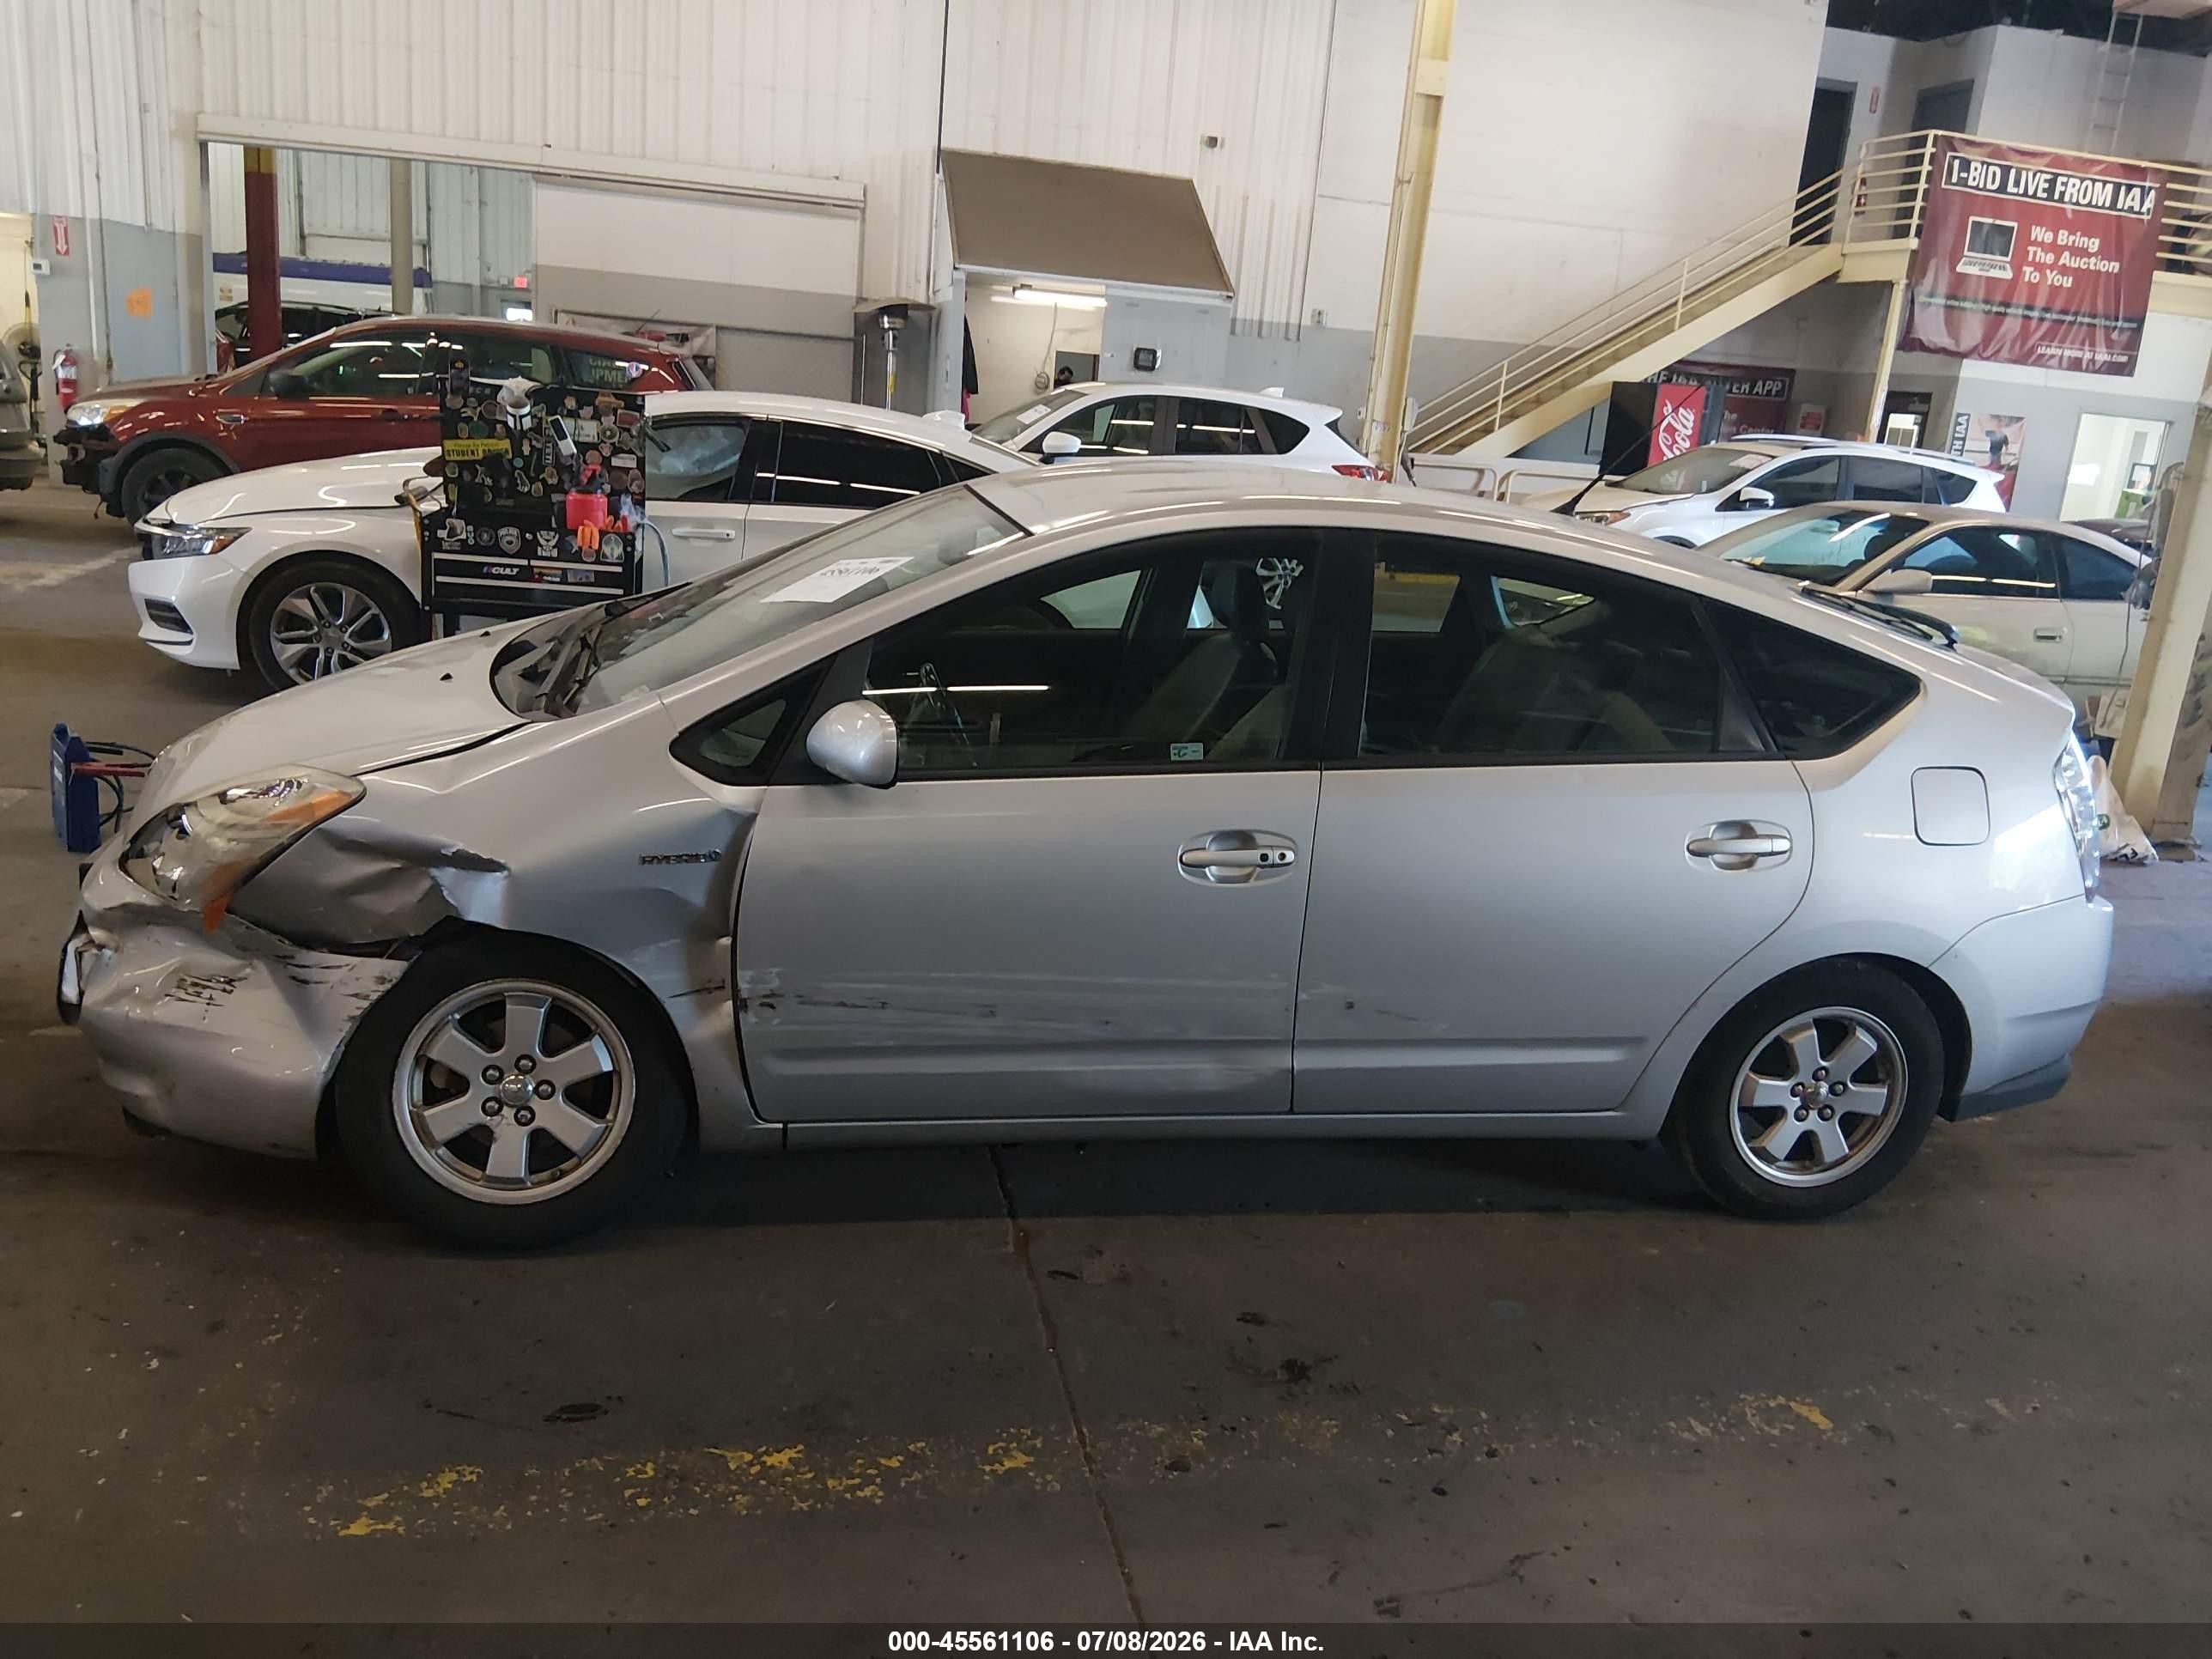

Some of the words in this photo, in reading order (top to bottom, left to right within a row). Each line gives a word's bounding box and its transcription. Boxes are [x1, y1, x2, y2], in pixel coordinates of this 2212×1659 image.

[1951, 159, 2001, 191] I-BID
[2007, 168, 2052, 199] LIVE
[2054, 176, 2113, 207] FROM
[2117, 185, 2155, 213] IAA
[2031, 225, 2054, 243] We
[2057, 229, 2100, 252] Bring
[2027, 246, 2055, 264] The
[2058, 251, 2120, 273] Auction
[2022, 266, 2040, 283] To
[2045, 269, 2073, 288] You
[1753, 380, 1783, 396] APP
[1954, 415, 1968, 438] IAA
[447, 448, 479, 458] STUDENT
[1950, 440, 1963, 455] TH
